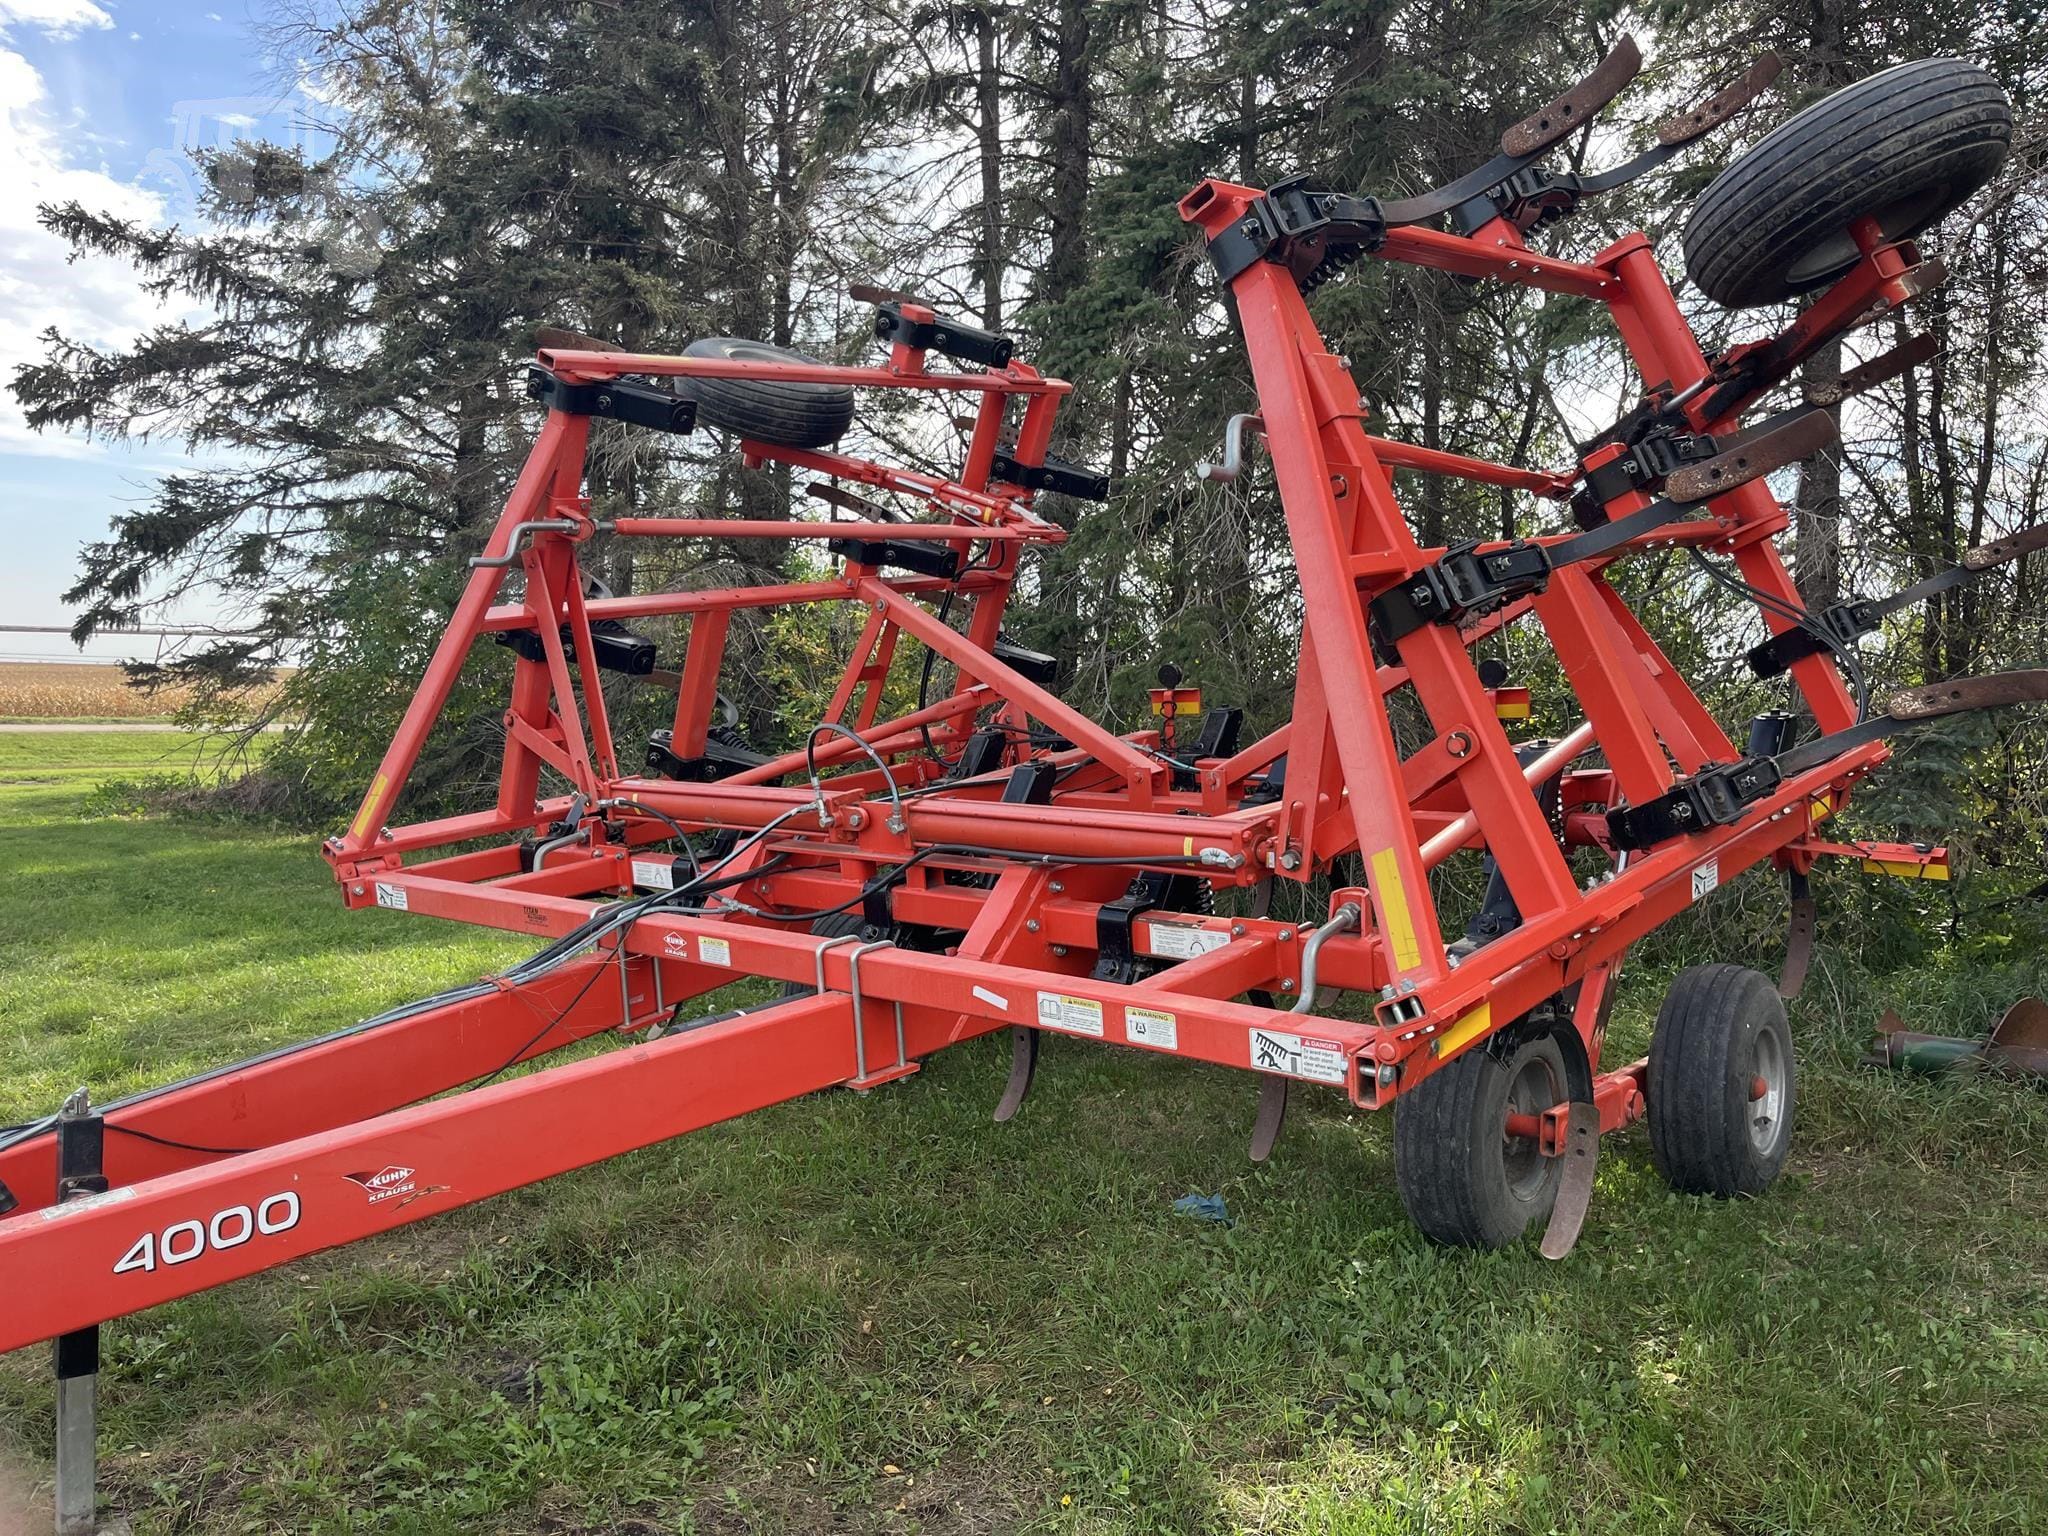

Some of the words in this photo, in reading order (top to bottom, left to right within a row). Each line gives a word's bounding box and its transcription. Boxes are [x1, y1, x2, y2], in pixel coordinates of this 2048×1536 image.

[1138, 1011, 1169, 1021] WARNING
[1311, 1040, 1338, 1050] DANGER
[372, 1170, 408, 1186] KUHN
[368, 1183, 416, 1202] KRAUSE
[112, 1191, 301, 1274] 4000
